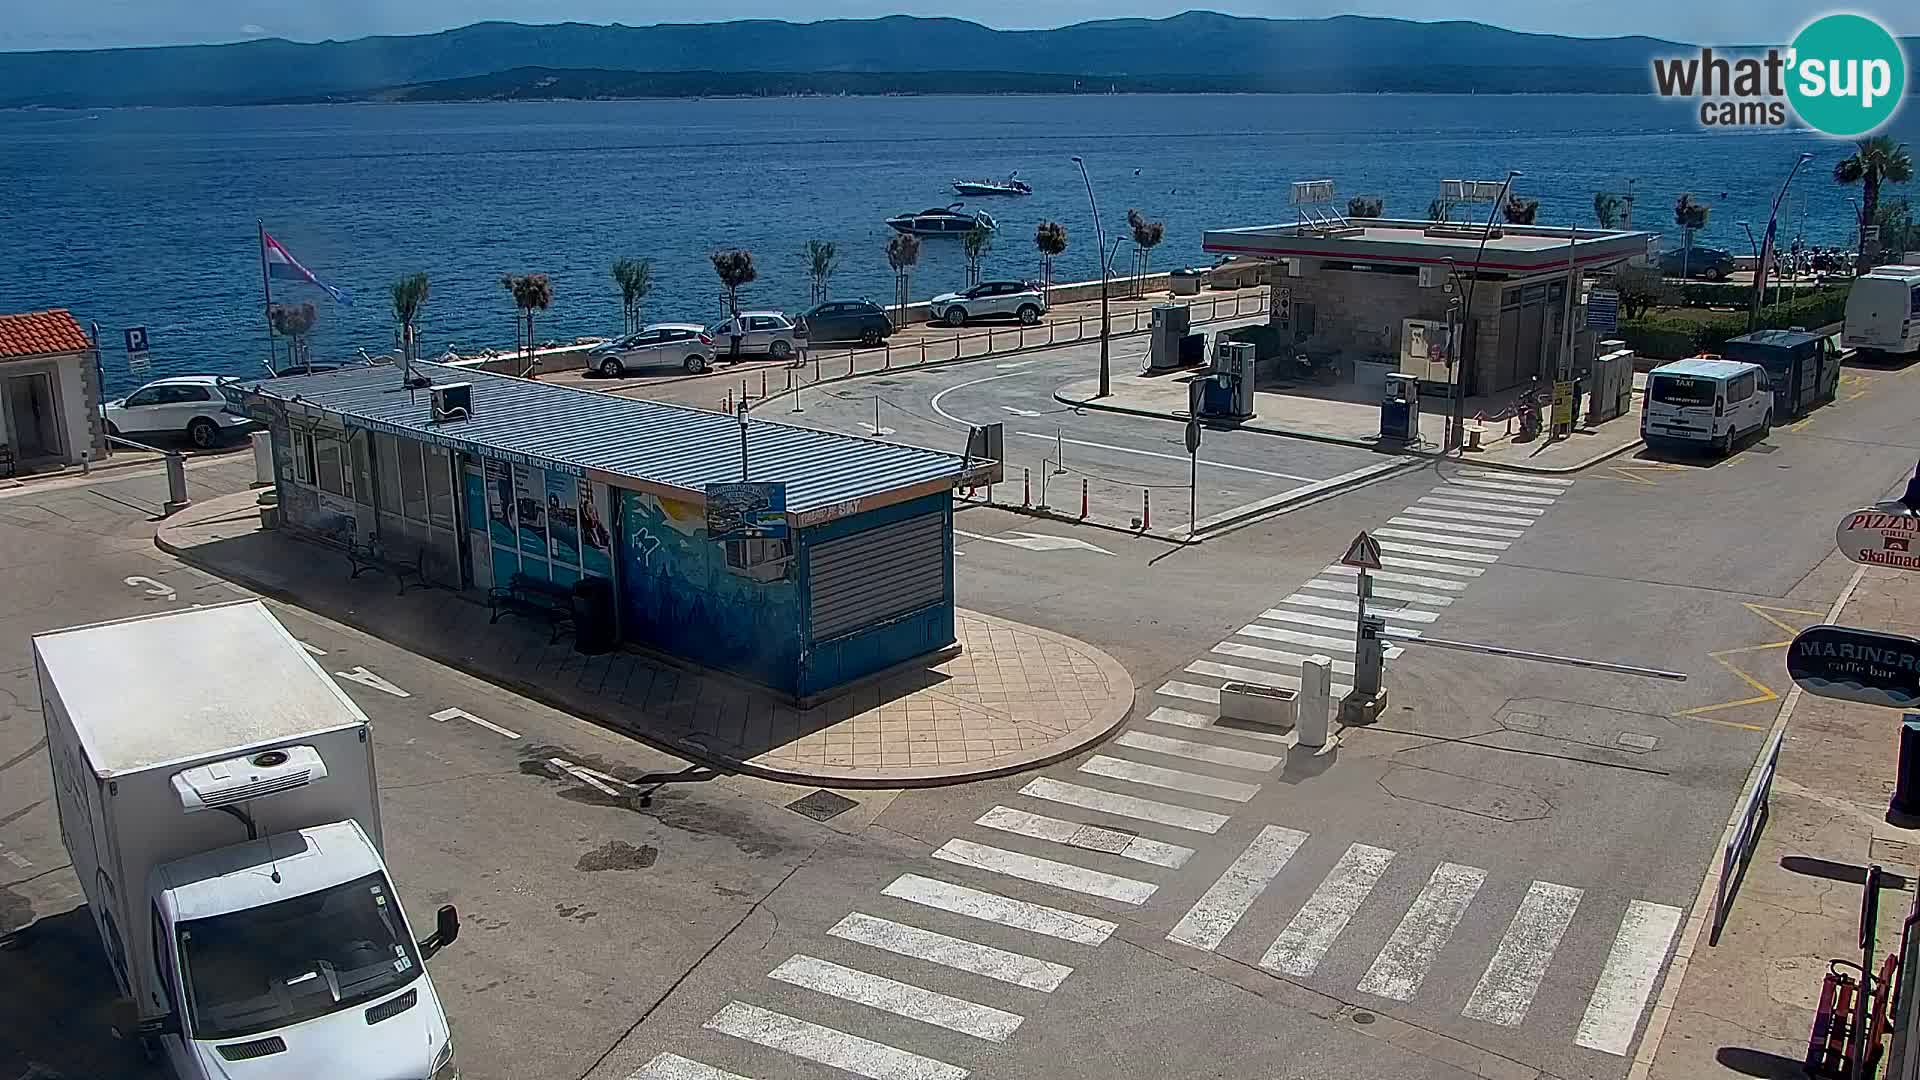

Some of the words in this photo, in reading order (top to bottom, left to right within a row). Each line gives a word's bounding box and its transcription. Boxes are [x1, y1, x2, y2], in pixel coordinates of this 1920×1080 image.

[130, 331, 141, 348] P
[1676, 379, 1694, 387] TAXI
[436, 436, 466, 450] POSTAJA
[478, 445, 492, 457] BUS
[493, 449, 525, 464] STATION
[528, 457, 554, 471] TICKET
[554, 462, 581, 477] OFFICE
[1880, 529, 1916, 540] GRILL
[1800, 642, 1920, 673] MARINER
[1828, 662, 1865, 672] caffe
[1870, 665, 1896, 679] bar
